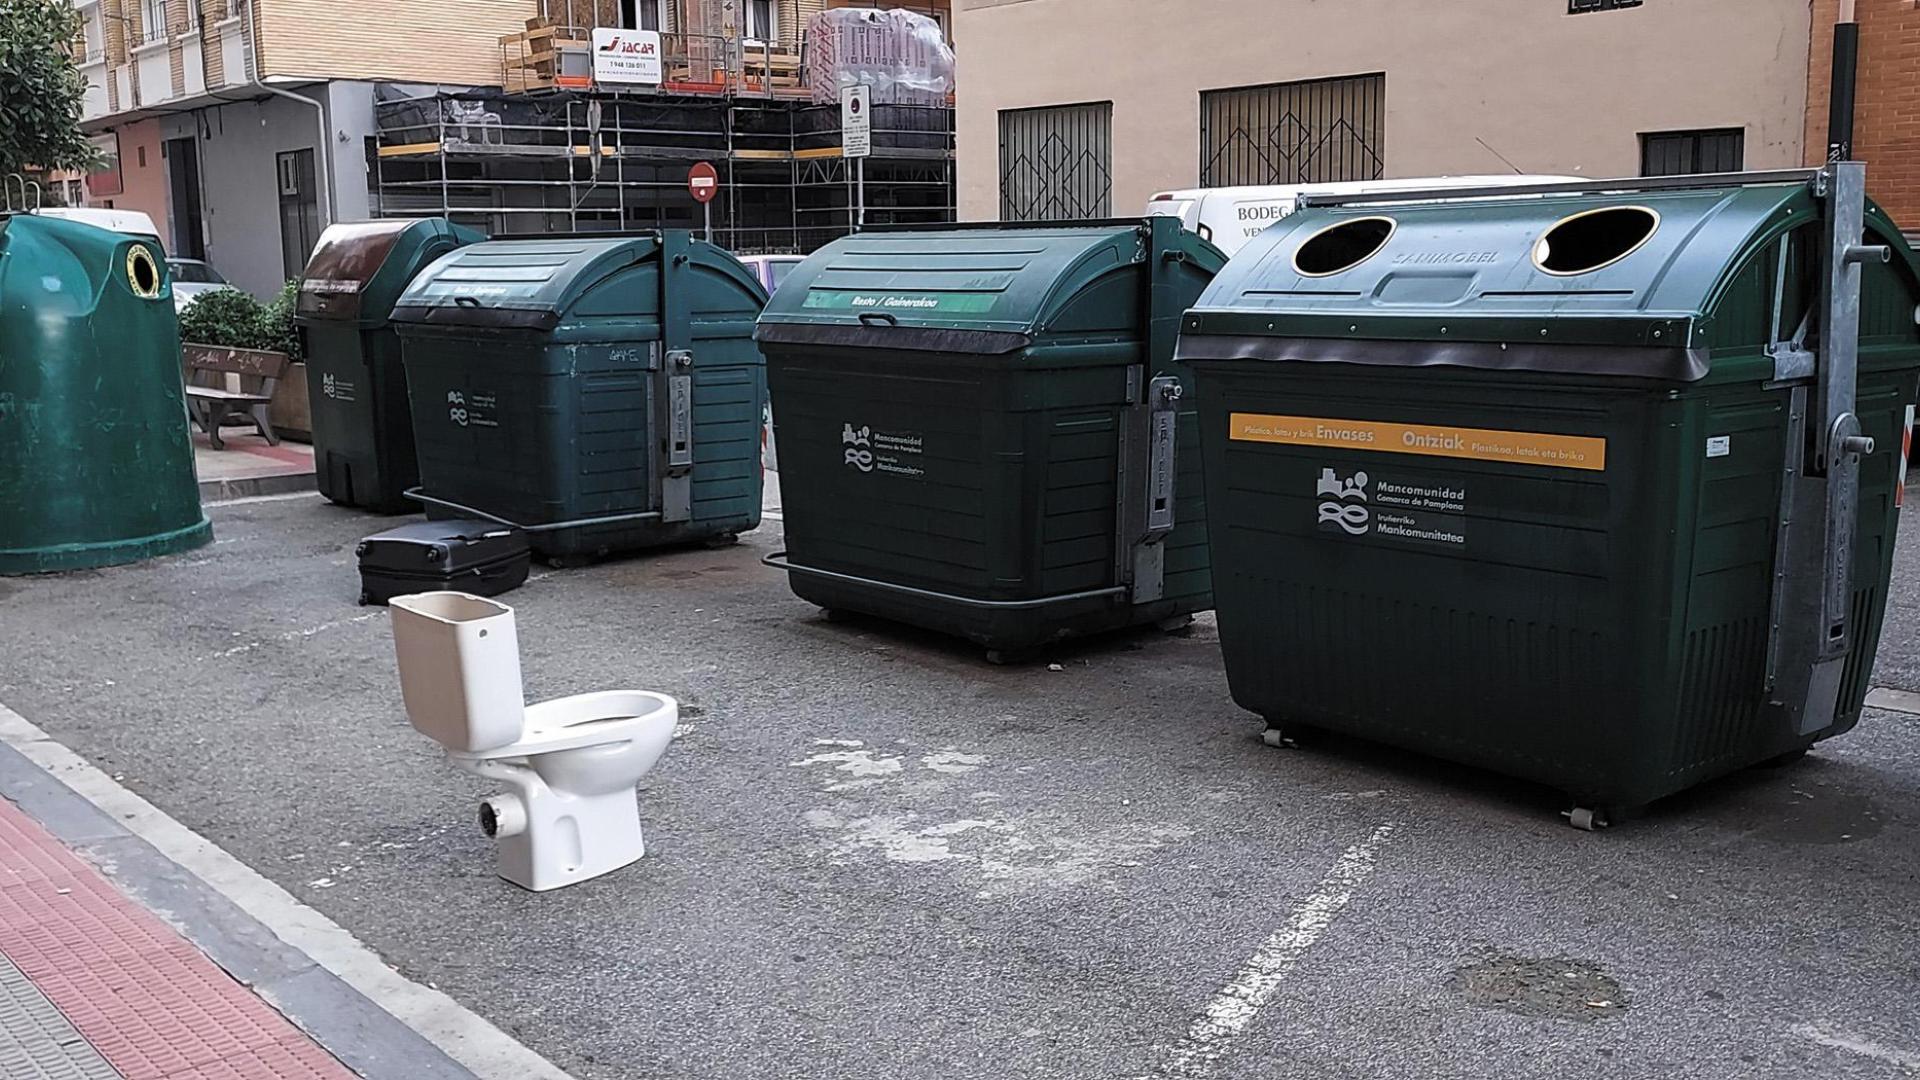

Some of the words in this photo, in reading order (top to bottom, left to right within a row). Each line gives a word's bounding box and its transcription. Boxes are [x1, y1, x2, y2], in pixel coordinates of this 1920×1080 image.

[874, 433, 922, 446] Mancomunidad
[1316, 424, 1375, 442] Envases
[1402, 430, 1465, 450] Ontziak
[1471, 442, 1514, 456] Plastikoa,
[1516, 446, 1540, 457] latak
[1541, 449, 1557, 459] eta
[1558, 449, 1585, 462] brika
[1377, 481, 1465, 500] Mancomunidad
[1376, 493, 1410, 505] Comarca
[1411, 497, 1422, 506] de
[1423, 499, 1464, 511] Pamplona
[1377, 523, 1465, 543] Mankomunitatea
